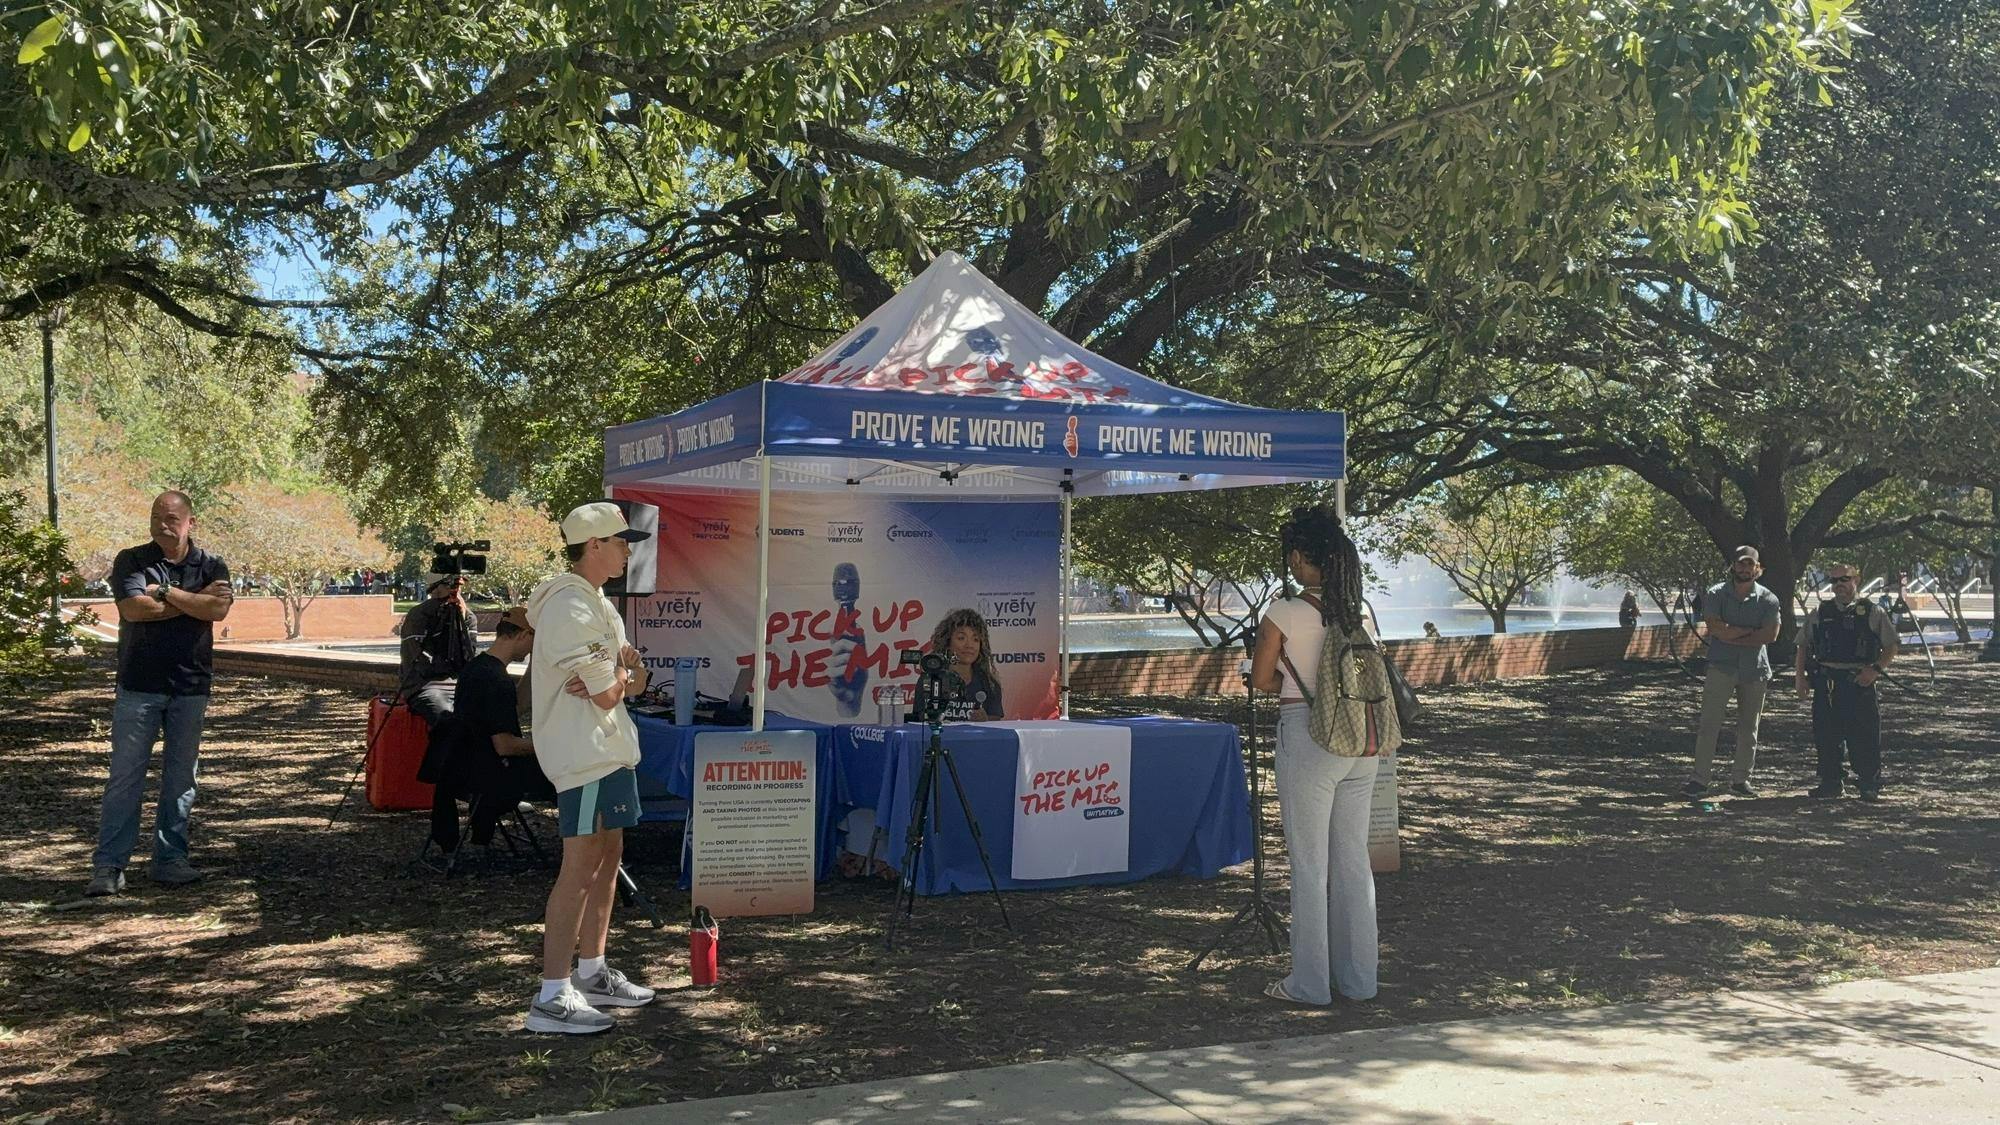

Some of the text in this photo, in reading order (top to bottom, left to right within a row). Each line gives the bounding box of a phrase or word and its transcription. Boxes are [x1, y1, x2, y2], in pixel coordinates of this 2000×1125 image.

[898, 361, 1018, 386] PICK
[677, 414, 735, 454] PROVE ME WRONG
[851, 410, 1045, 449] PROVE ME WRONG
[620, 434, 665, 467] PROVE ME WRONG
[1098, 425, 1272, 458] PROVE ME WRONG
[768, 528, 805, 536] TUDENTS
[892, 530, 933, 538] STUDENTS
[656, 597, 702, 618] yrēfy
[994, 597, 1036, 617] yrēfy
[638, 619, 702, 629] YREFY.COM
[765, 600, 924, 645] PICK UP
[985, 617, 1037, 628] REFY.COM
[992, 652, 1046, 664] TUDENTS
[736, 648, 834, 694] THE
[855, 726, 886, 743] COLLEGE
[703, 761, 807, 783] ATTENTION:
[1032, 763, 1110, 790] PICK UP
[763, 782, 804, 790] PROGRESS
[1020, 780, 1121, 816] THE MIC
